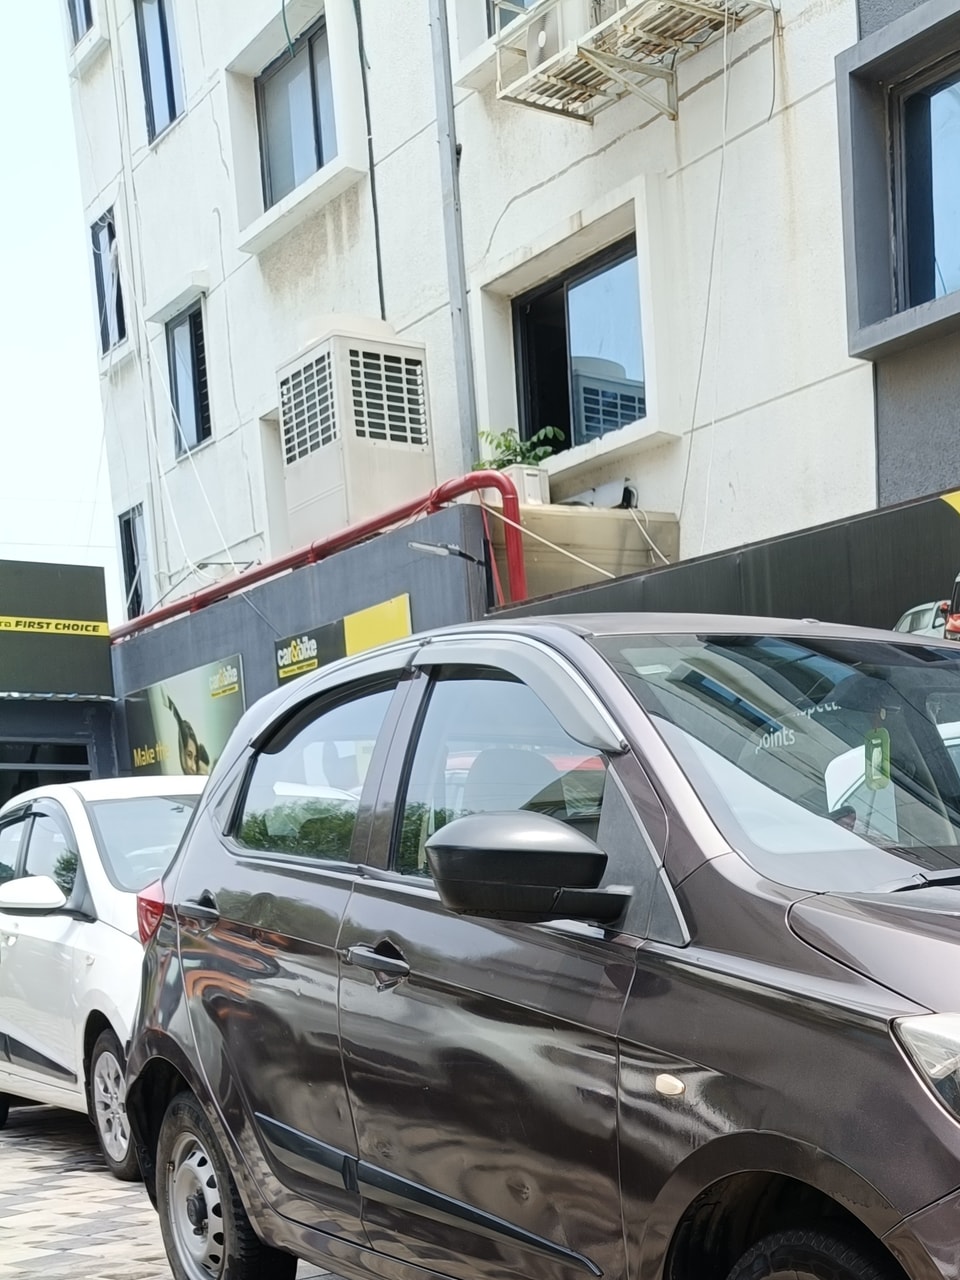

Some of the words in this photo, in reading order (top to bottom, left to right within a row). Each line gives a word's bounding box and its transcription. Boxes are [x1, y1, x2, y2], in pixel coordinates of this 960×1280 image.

[15, 620, 52, 630] FIRST
[54, 622, 100, 633] CHOICE
[277, 635, 318, 667] car&bike
[133, 744, 156, 768] Make
